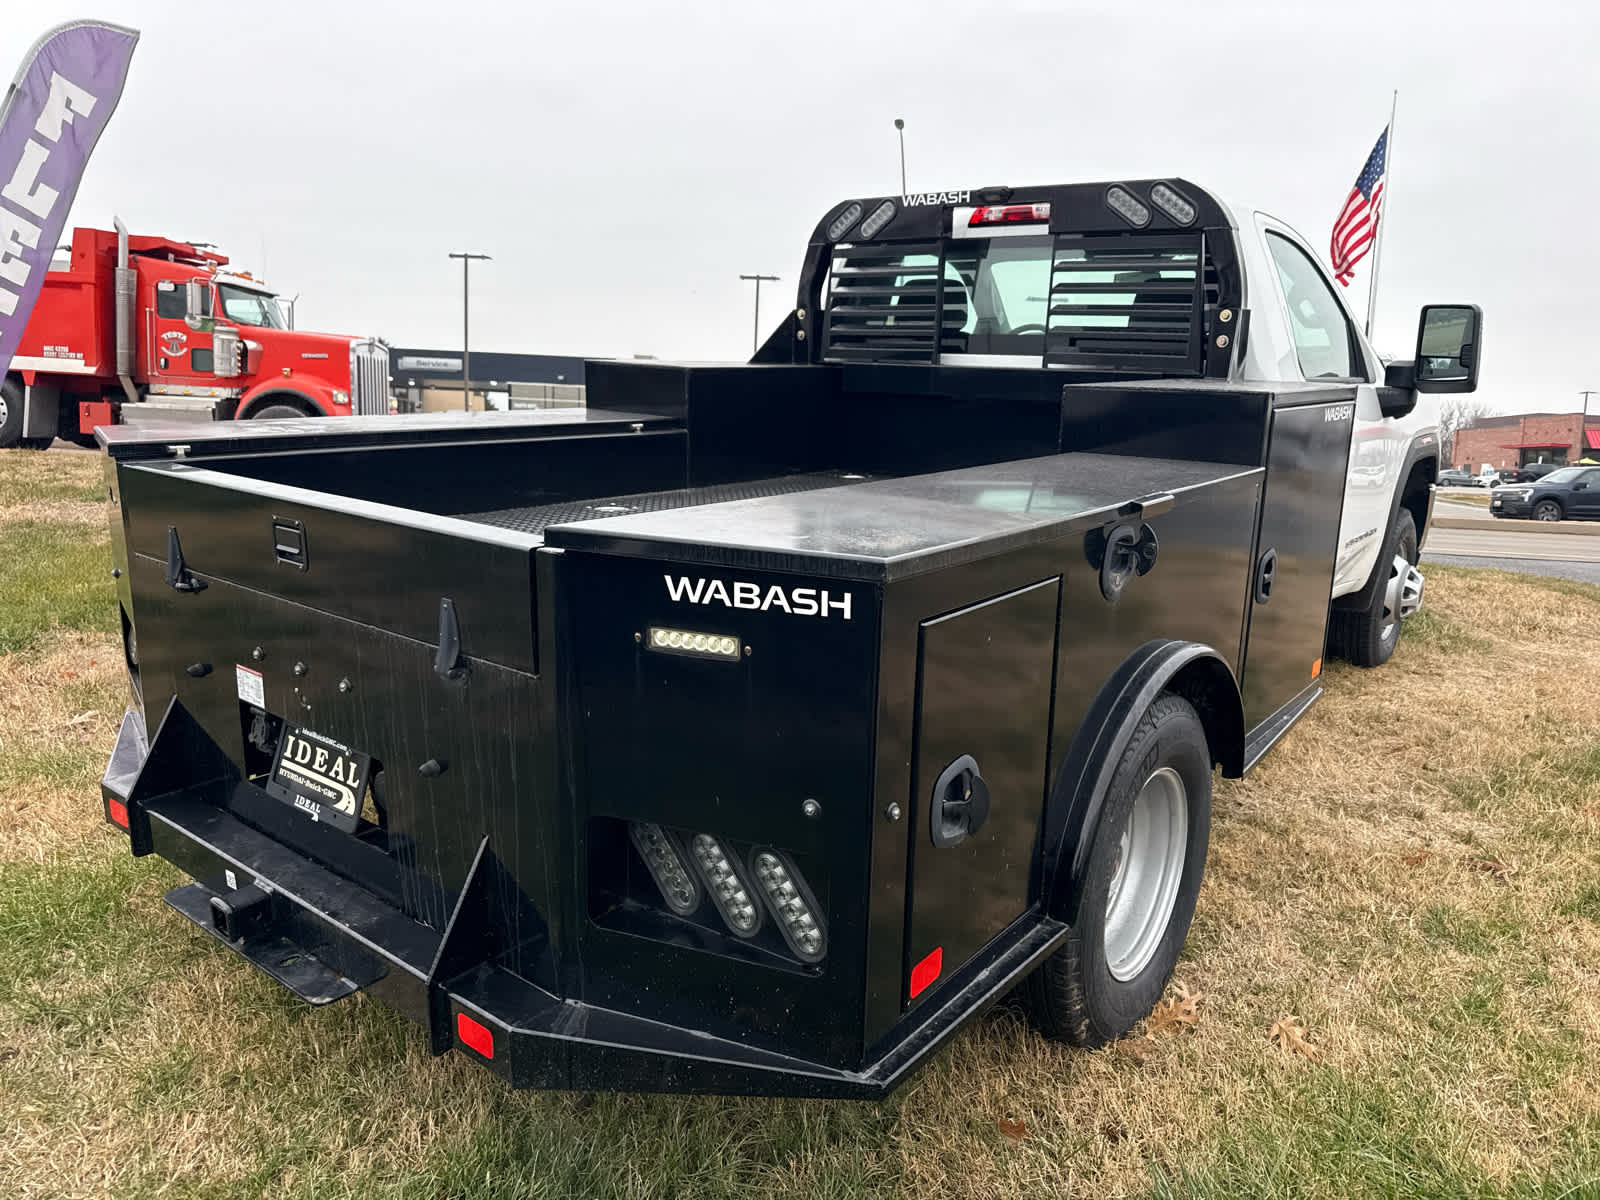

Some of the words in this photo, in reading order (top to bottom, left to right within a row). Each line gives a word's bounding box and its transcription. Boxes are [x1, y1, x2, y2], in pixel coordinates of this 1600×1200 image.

[902, 190, 970, 208] WABASH
[416, 359, 449, 369] Service
[1324, 406, 1353, 422] WABASH
[664, 574, 852, 620] WABASH
[283, 734, 360, 789] IDEAL
[294, 794, 321, 813] IDEAL
